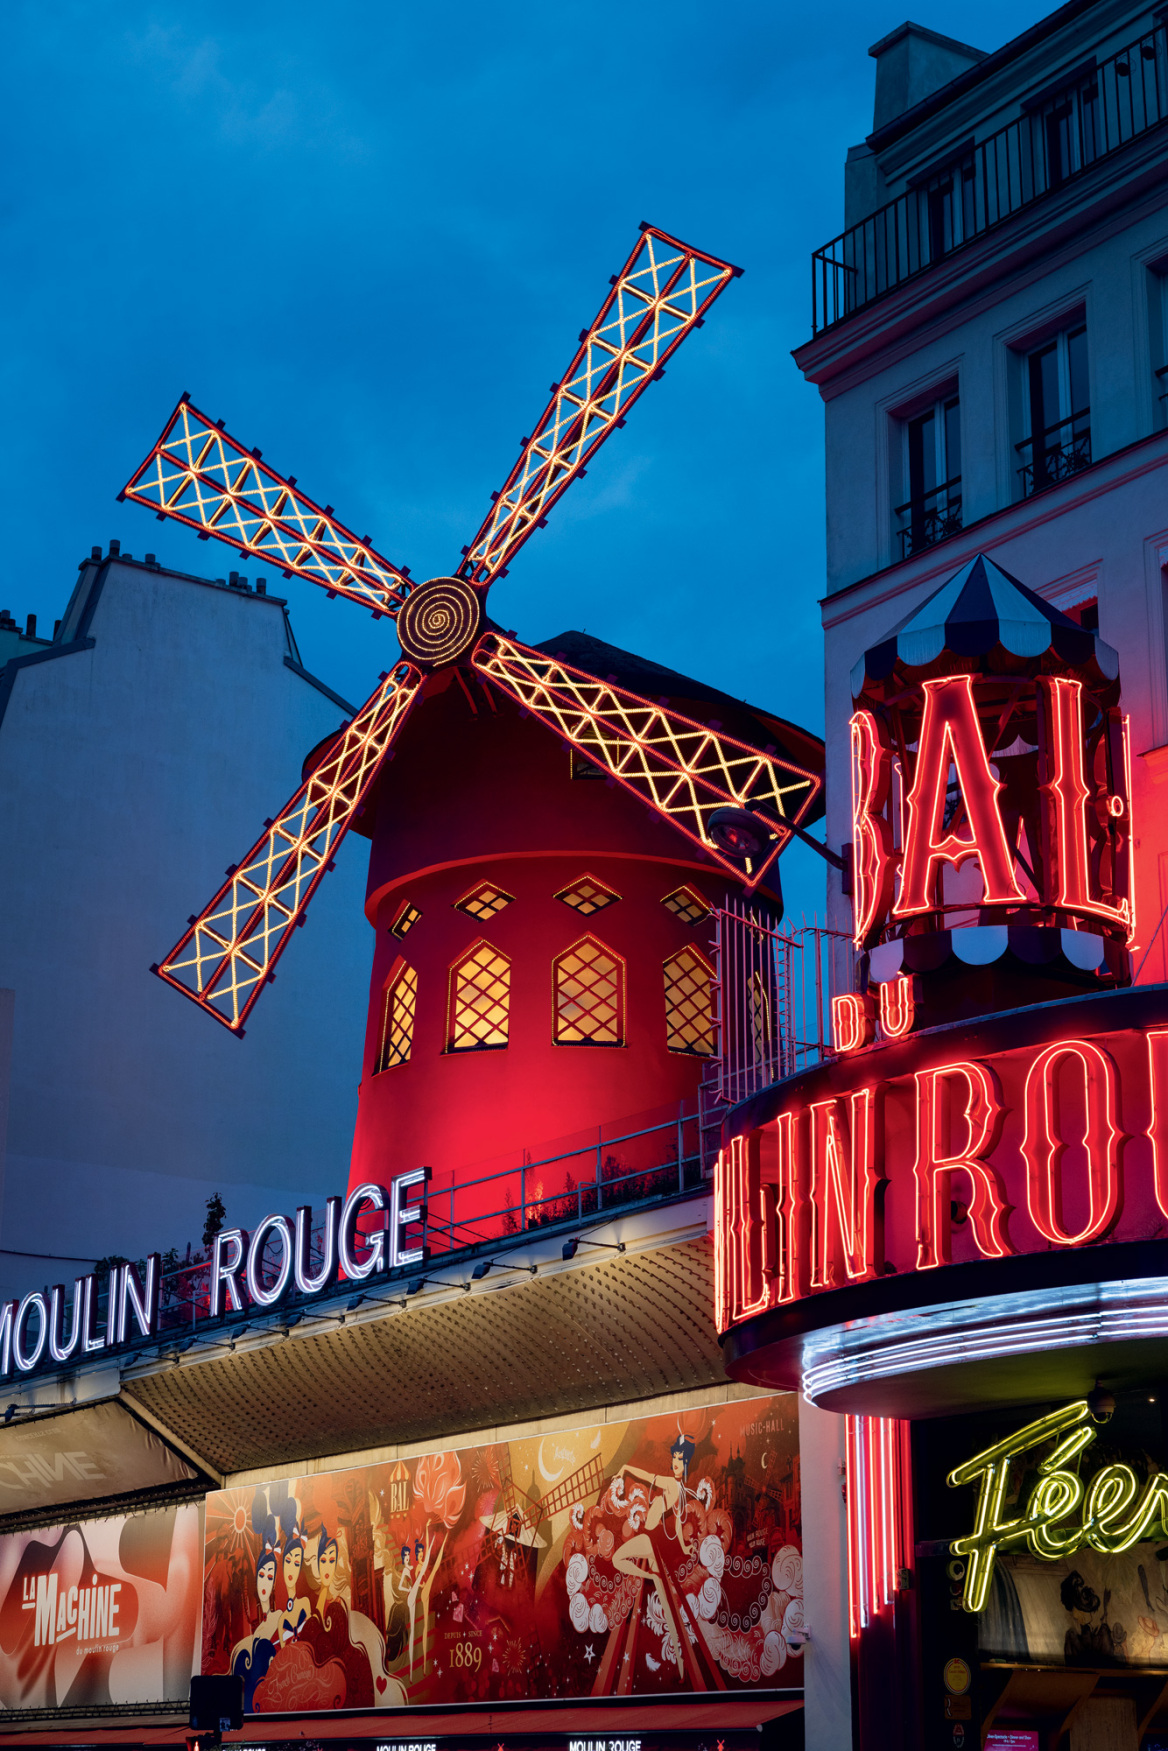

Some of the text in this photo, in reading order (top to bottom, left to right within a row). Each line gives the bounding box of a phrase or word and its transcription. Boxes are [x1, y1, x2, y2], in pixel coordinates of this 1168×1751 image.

[849, 675, 1131, 948] BAL
[832, 975, 914, 1052] DU
[210, 1166, 431, 1317] ROUGE
[740, 1418, 784, 1437] MUSIC-HALL
[390, 1481, 409, 1513] BAL
[23, 1576, 35, 1601] LA
[103, 1644, 119, 1654] rouge
[449, 1642, 482, 1672] 1889
[569, 1740, 605, 1751] MOULIN
